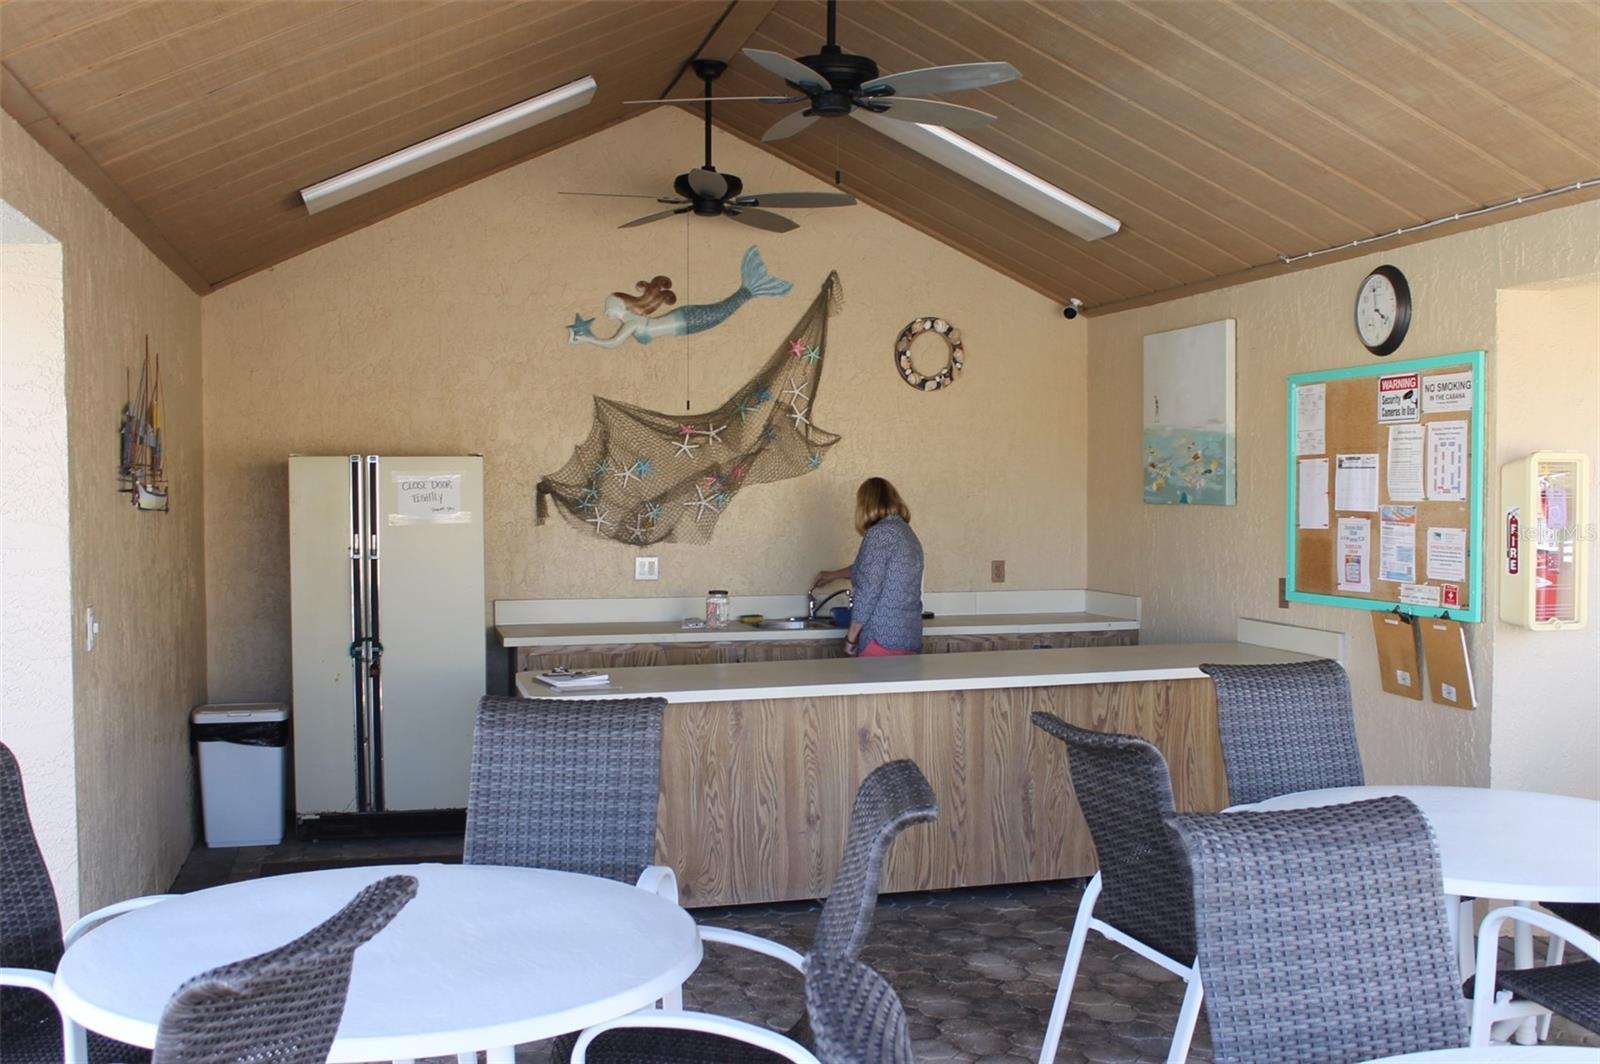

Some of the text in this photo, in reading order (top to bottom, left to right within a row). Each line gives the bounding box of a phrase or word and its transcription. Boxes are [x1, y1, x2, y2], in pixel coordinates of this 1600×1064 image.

[1382, 377, 1417, 390] WARNING
[1425, 380, 1472, 392] NO SMOKING
[1382, 394, 1401, 406] Security
[1446, 392, 1466, 400] CABANA
[1382, 407, 1401, 417] Cameras
[1407, 404, 1416, 416] Use
[402, 480, 427, 491] CLOSE
[1510, 524, 1518, 571] FIRE
